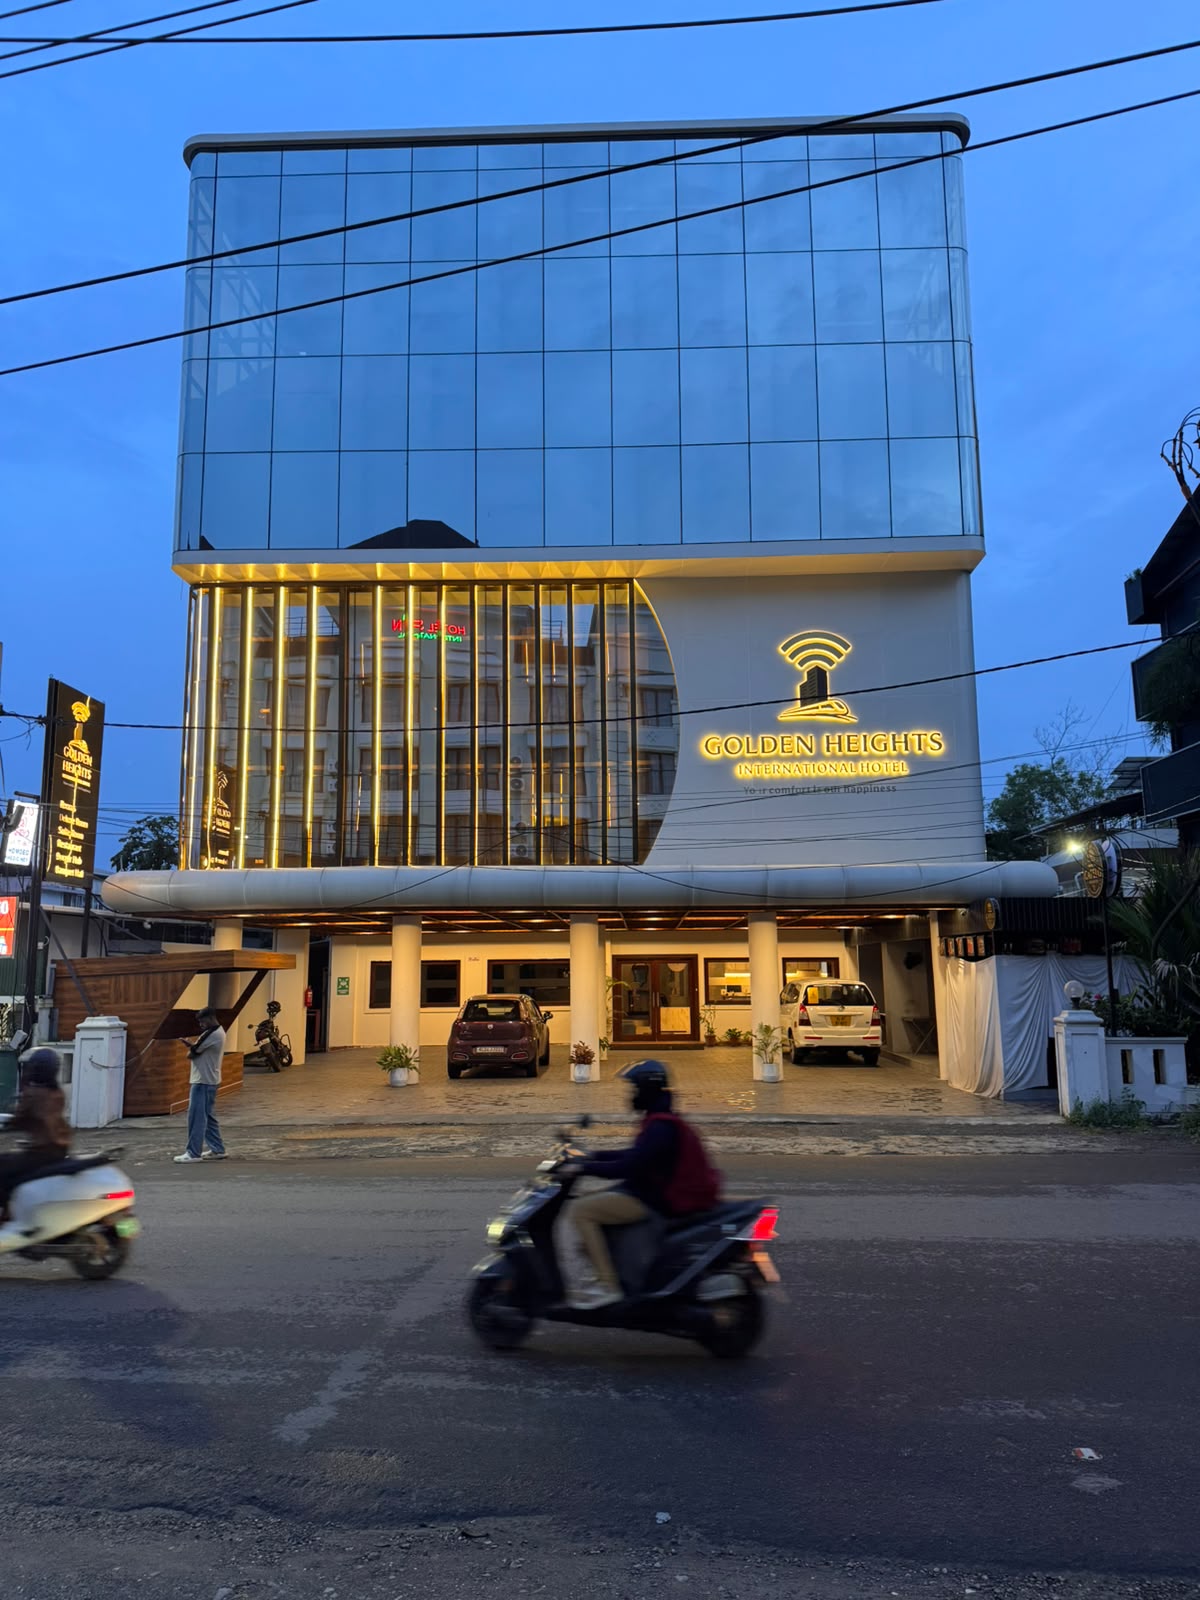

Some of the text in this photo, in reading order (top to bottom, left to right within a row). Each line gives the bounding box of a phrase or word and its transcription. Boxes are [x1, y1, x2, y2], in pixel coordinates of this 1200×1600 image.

[703, 732, 944, 756] GOLDEN HEIGHTS
[63, 745, 93, 767] GOLDEN
[62, 760, 92, 780] HEIGHTS
[738, 761, 909, 776] INTERNATIONAL HOTEL
